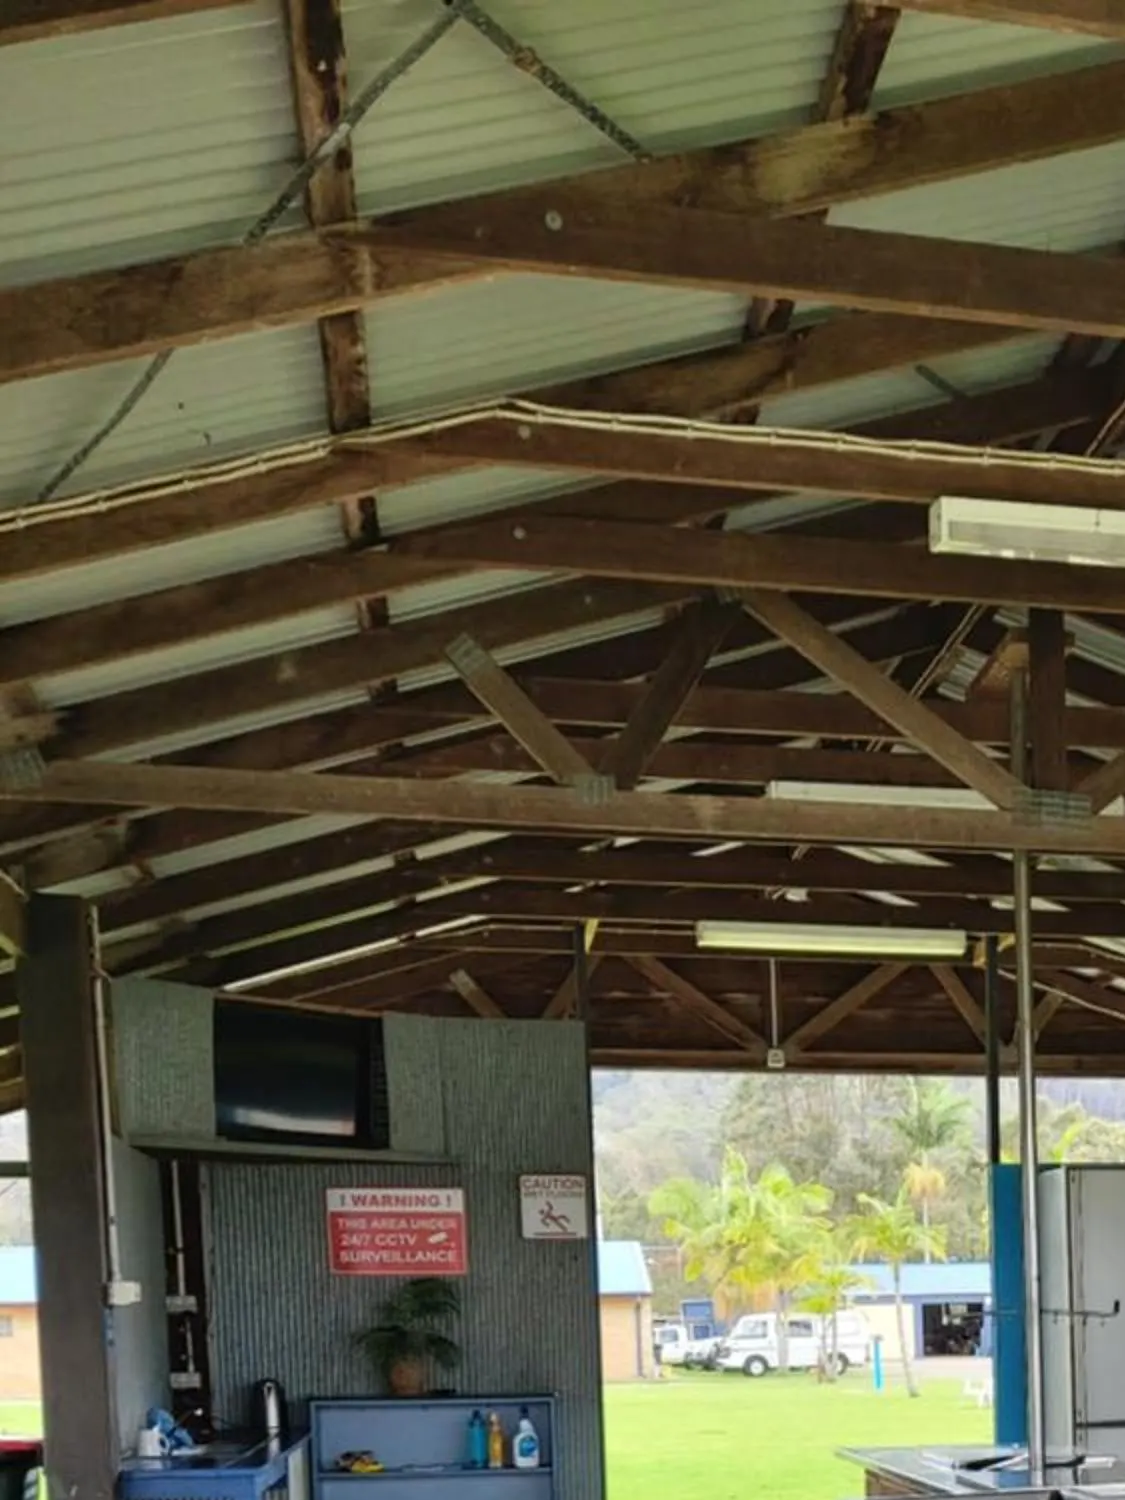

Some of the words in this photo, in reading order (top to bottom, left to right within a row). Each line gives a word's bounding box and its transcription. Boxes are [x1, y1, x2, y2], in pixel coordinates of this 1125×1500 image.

[522, 1178, 584, 1190] CAUTION
[351, 1194, 440, 1207] WARNING
[338, 1218, 366, 1229] THIS
[370, 1218, 409, 1229] AREA
[410, 1217, 458, 1229] UNDER
[340, 1233, 370, 1246] 24/7
[374, 1232, 417, 1246] CCTV
[339, 1251, 457, 1263] SURVEILLANCE
